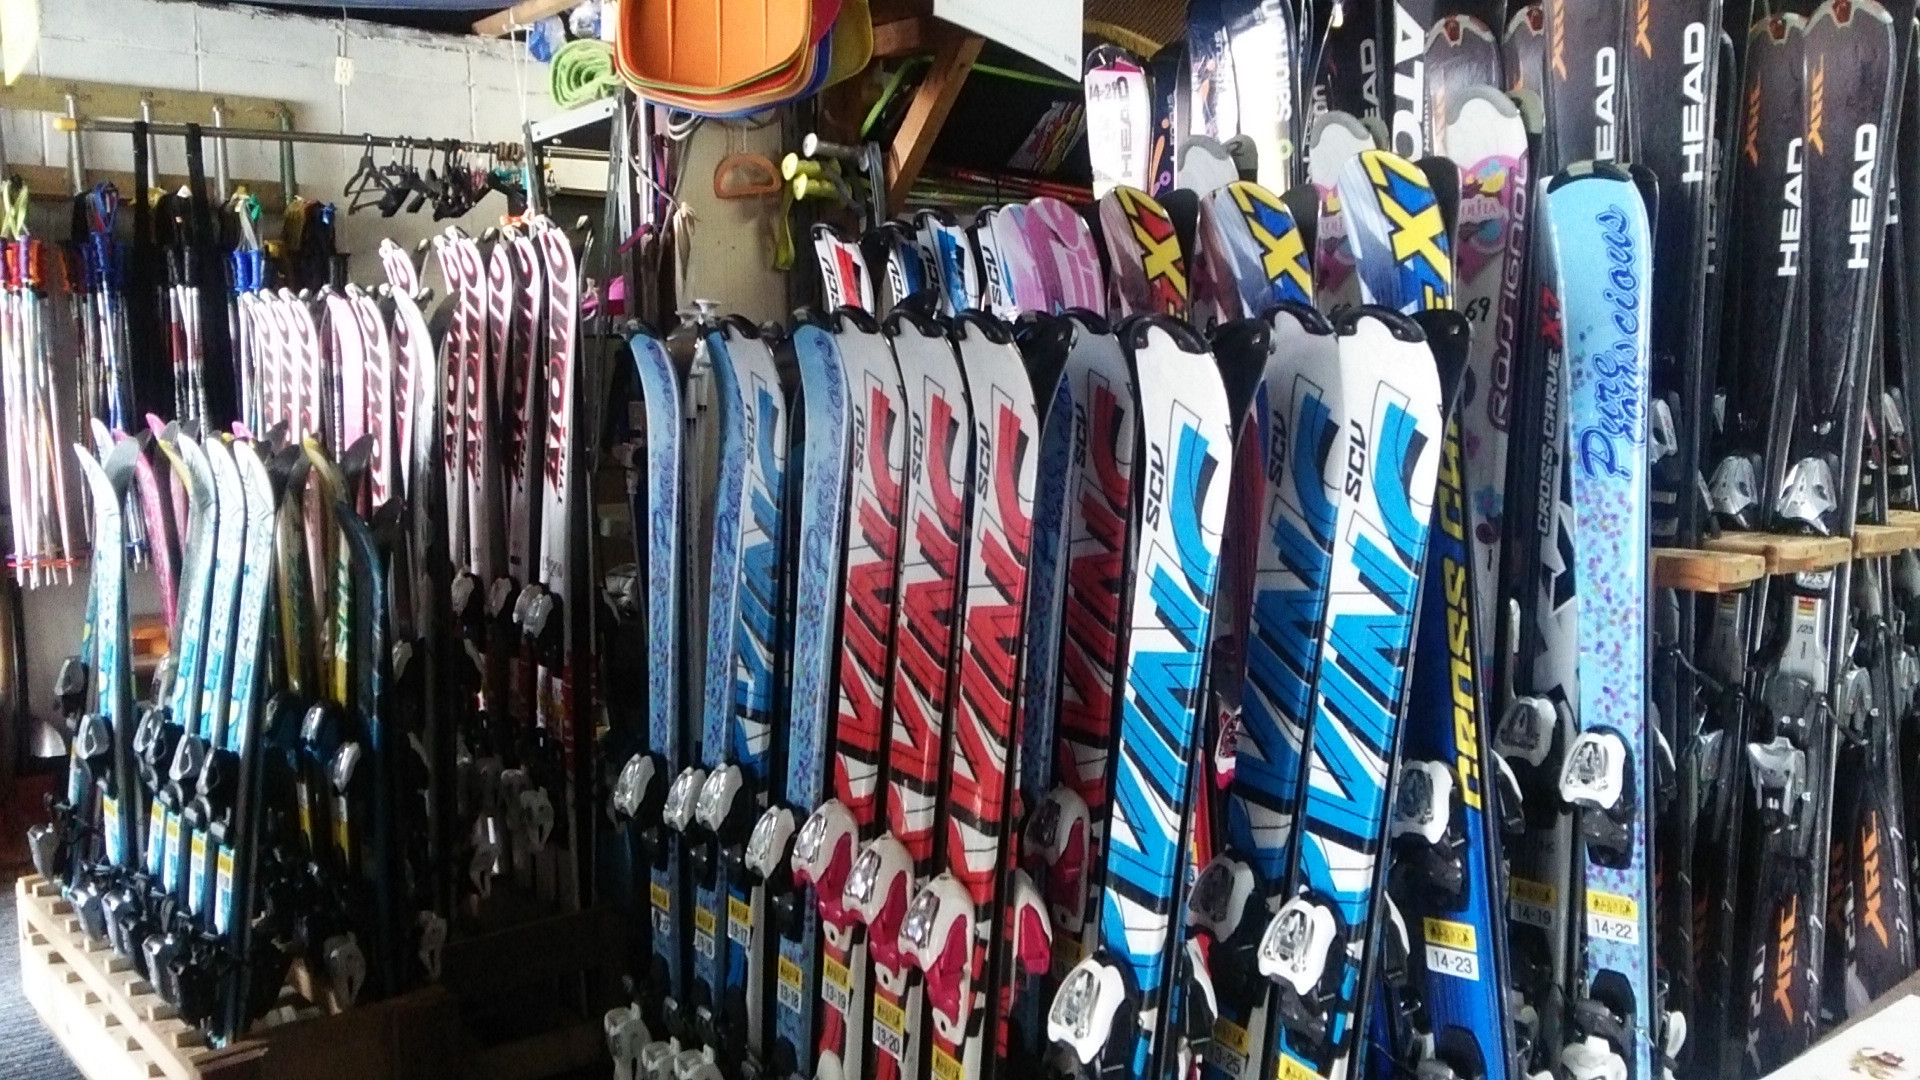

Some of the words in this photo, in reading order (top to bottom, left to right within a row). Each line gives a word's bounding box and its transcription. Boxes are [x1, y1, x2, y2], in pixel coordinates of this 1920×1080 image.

[1115, 75, 1132, 179] HEAD
[1360, 38, 1381, 120] EAD
[1391, 0, 1425, 164] ATO
[1596, 47, 1616, 161] EAD
[1682, 22, 1706, 183] HEAD
[1777, 137, 1803, 277] HEAD
[1847, 122, 1877, 269] HEAD
[1464, 297, 1491, 321] 69
[1489, 152, 1528, 431] ROSSIGNOL
[456, 240, 481, 482] ATOMIC
[509, 237, 533, 481] ATOMIC
[538, 231, 570, 496] ATOMIC
[1543, 349, 1560, 439] CARVE
[1578, 354, 1633, 480] Pure
[1538, 442, 1554, 535] CROSS
[1443, 560, 1483, 811] CROSS
[1432, 950, 1473, 975] 14-23
[1516, 906, 1552, 925] 14-19
[1594, 918, 1632, 939] 14-22
[779, 984, 800, 1009] 13-18
[824, 982, 846, 1010] 13-19
[876, 1026, 901, 1054] 13-20
